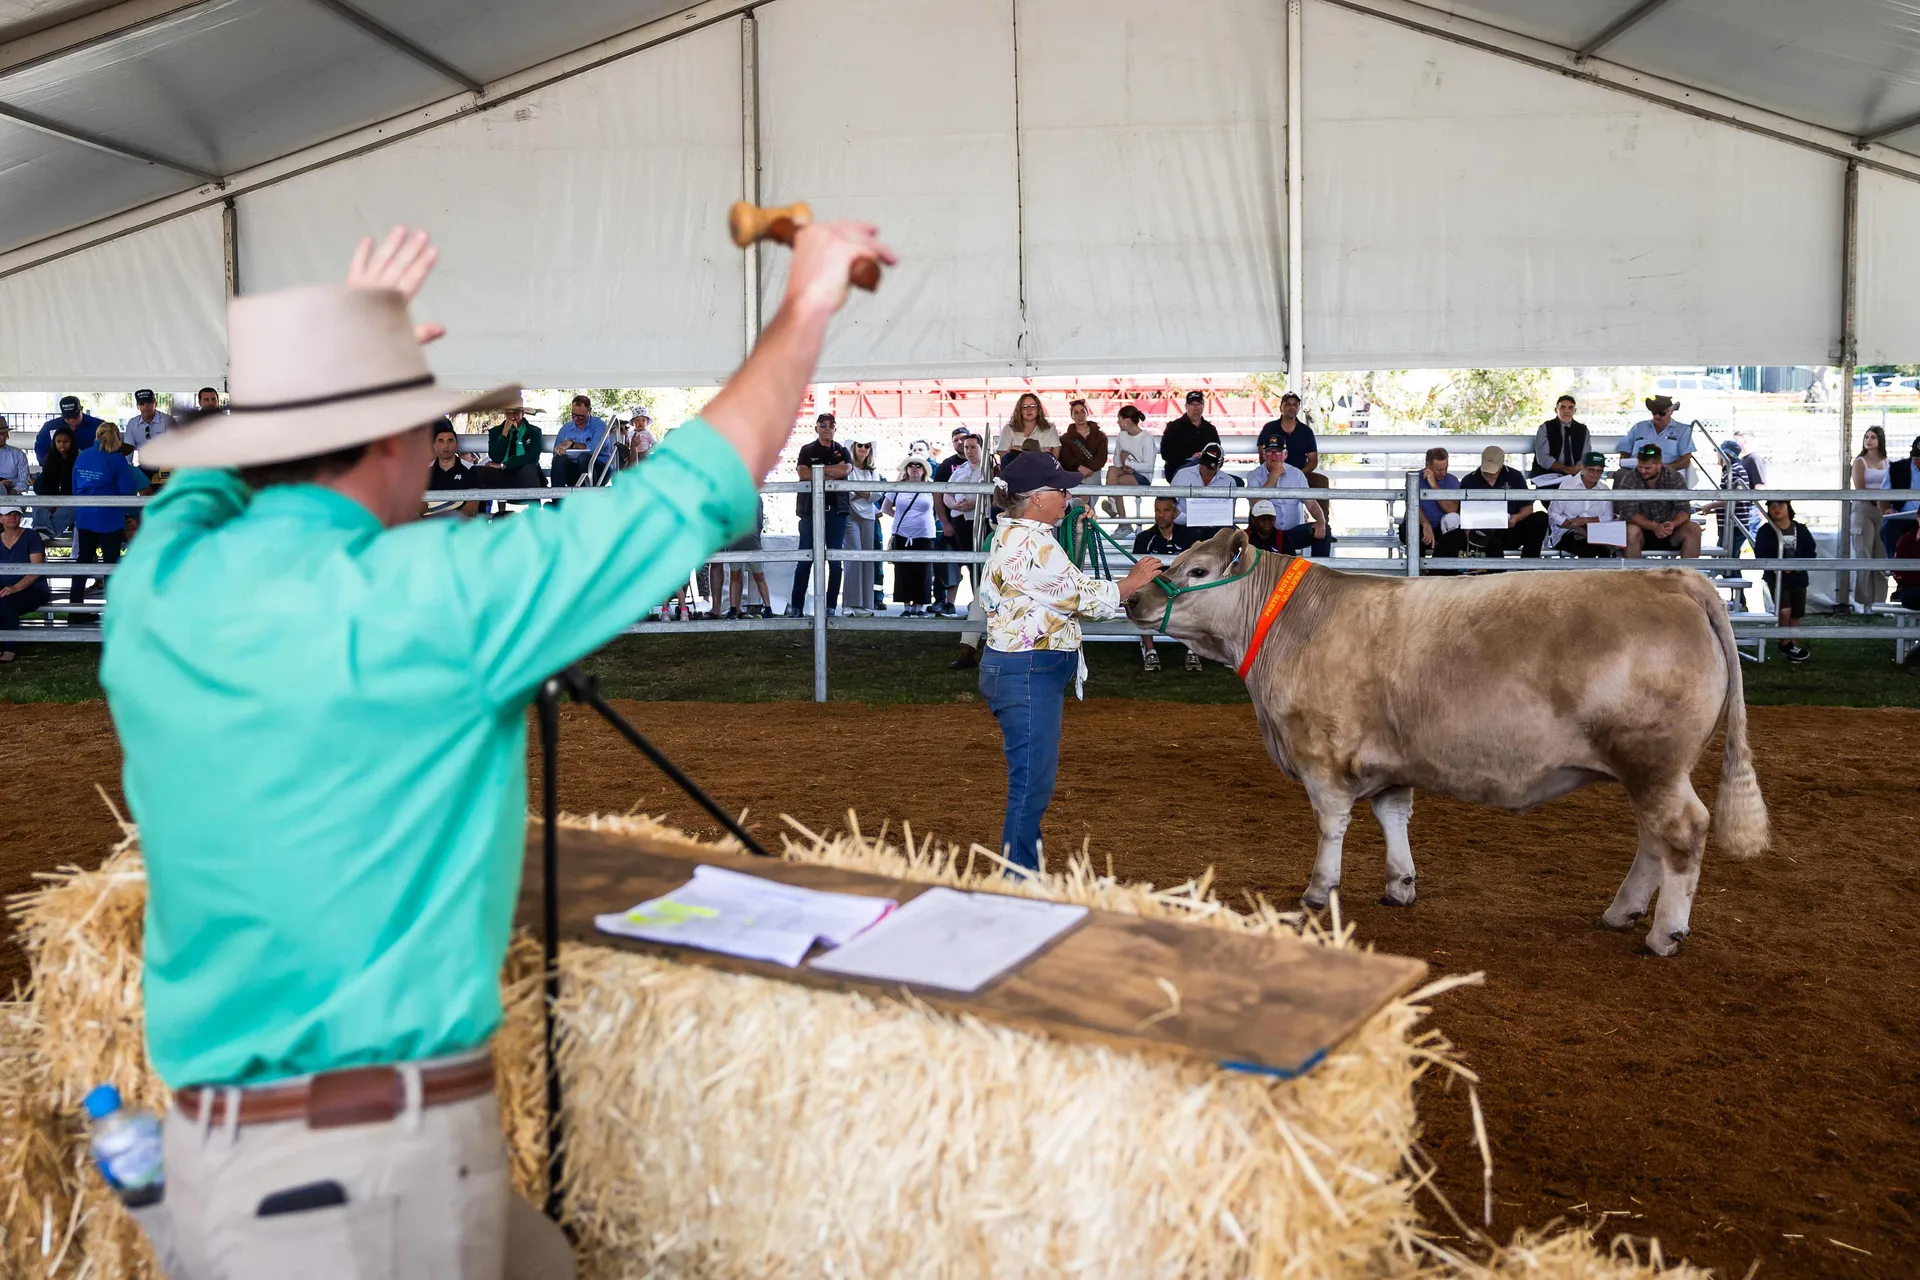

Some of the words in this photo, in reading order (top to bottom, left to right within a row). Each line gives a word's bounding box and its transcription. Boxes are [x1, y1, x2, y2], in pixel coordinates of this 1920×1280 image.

[1264, 593, 1280, 617] PERTH
[1278, 572, 1294, 593] ROYAL
[1281, 571, 1304, 602] QUALIFIER
